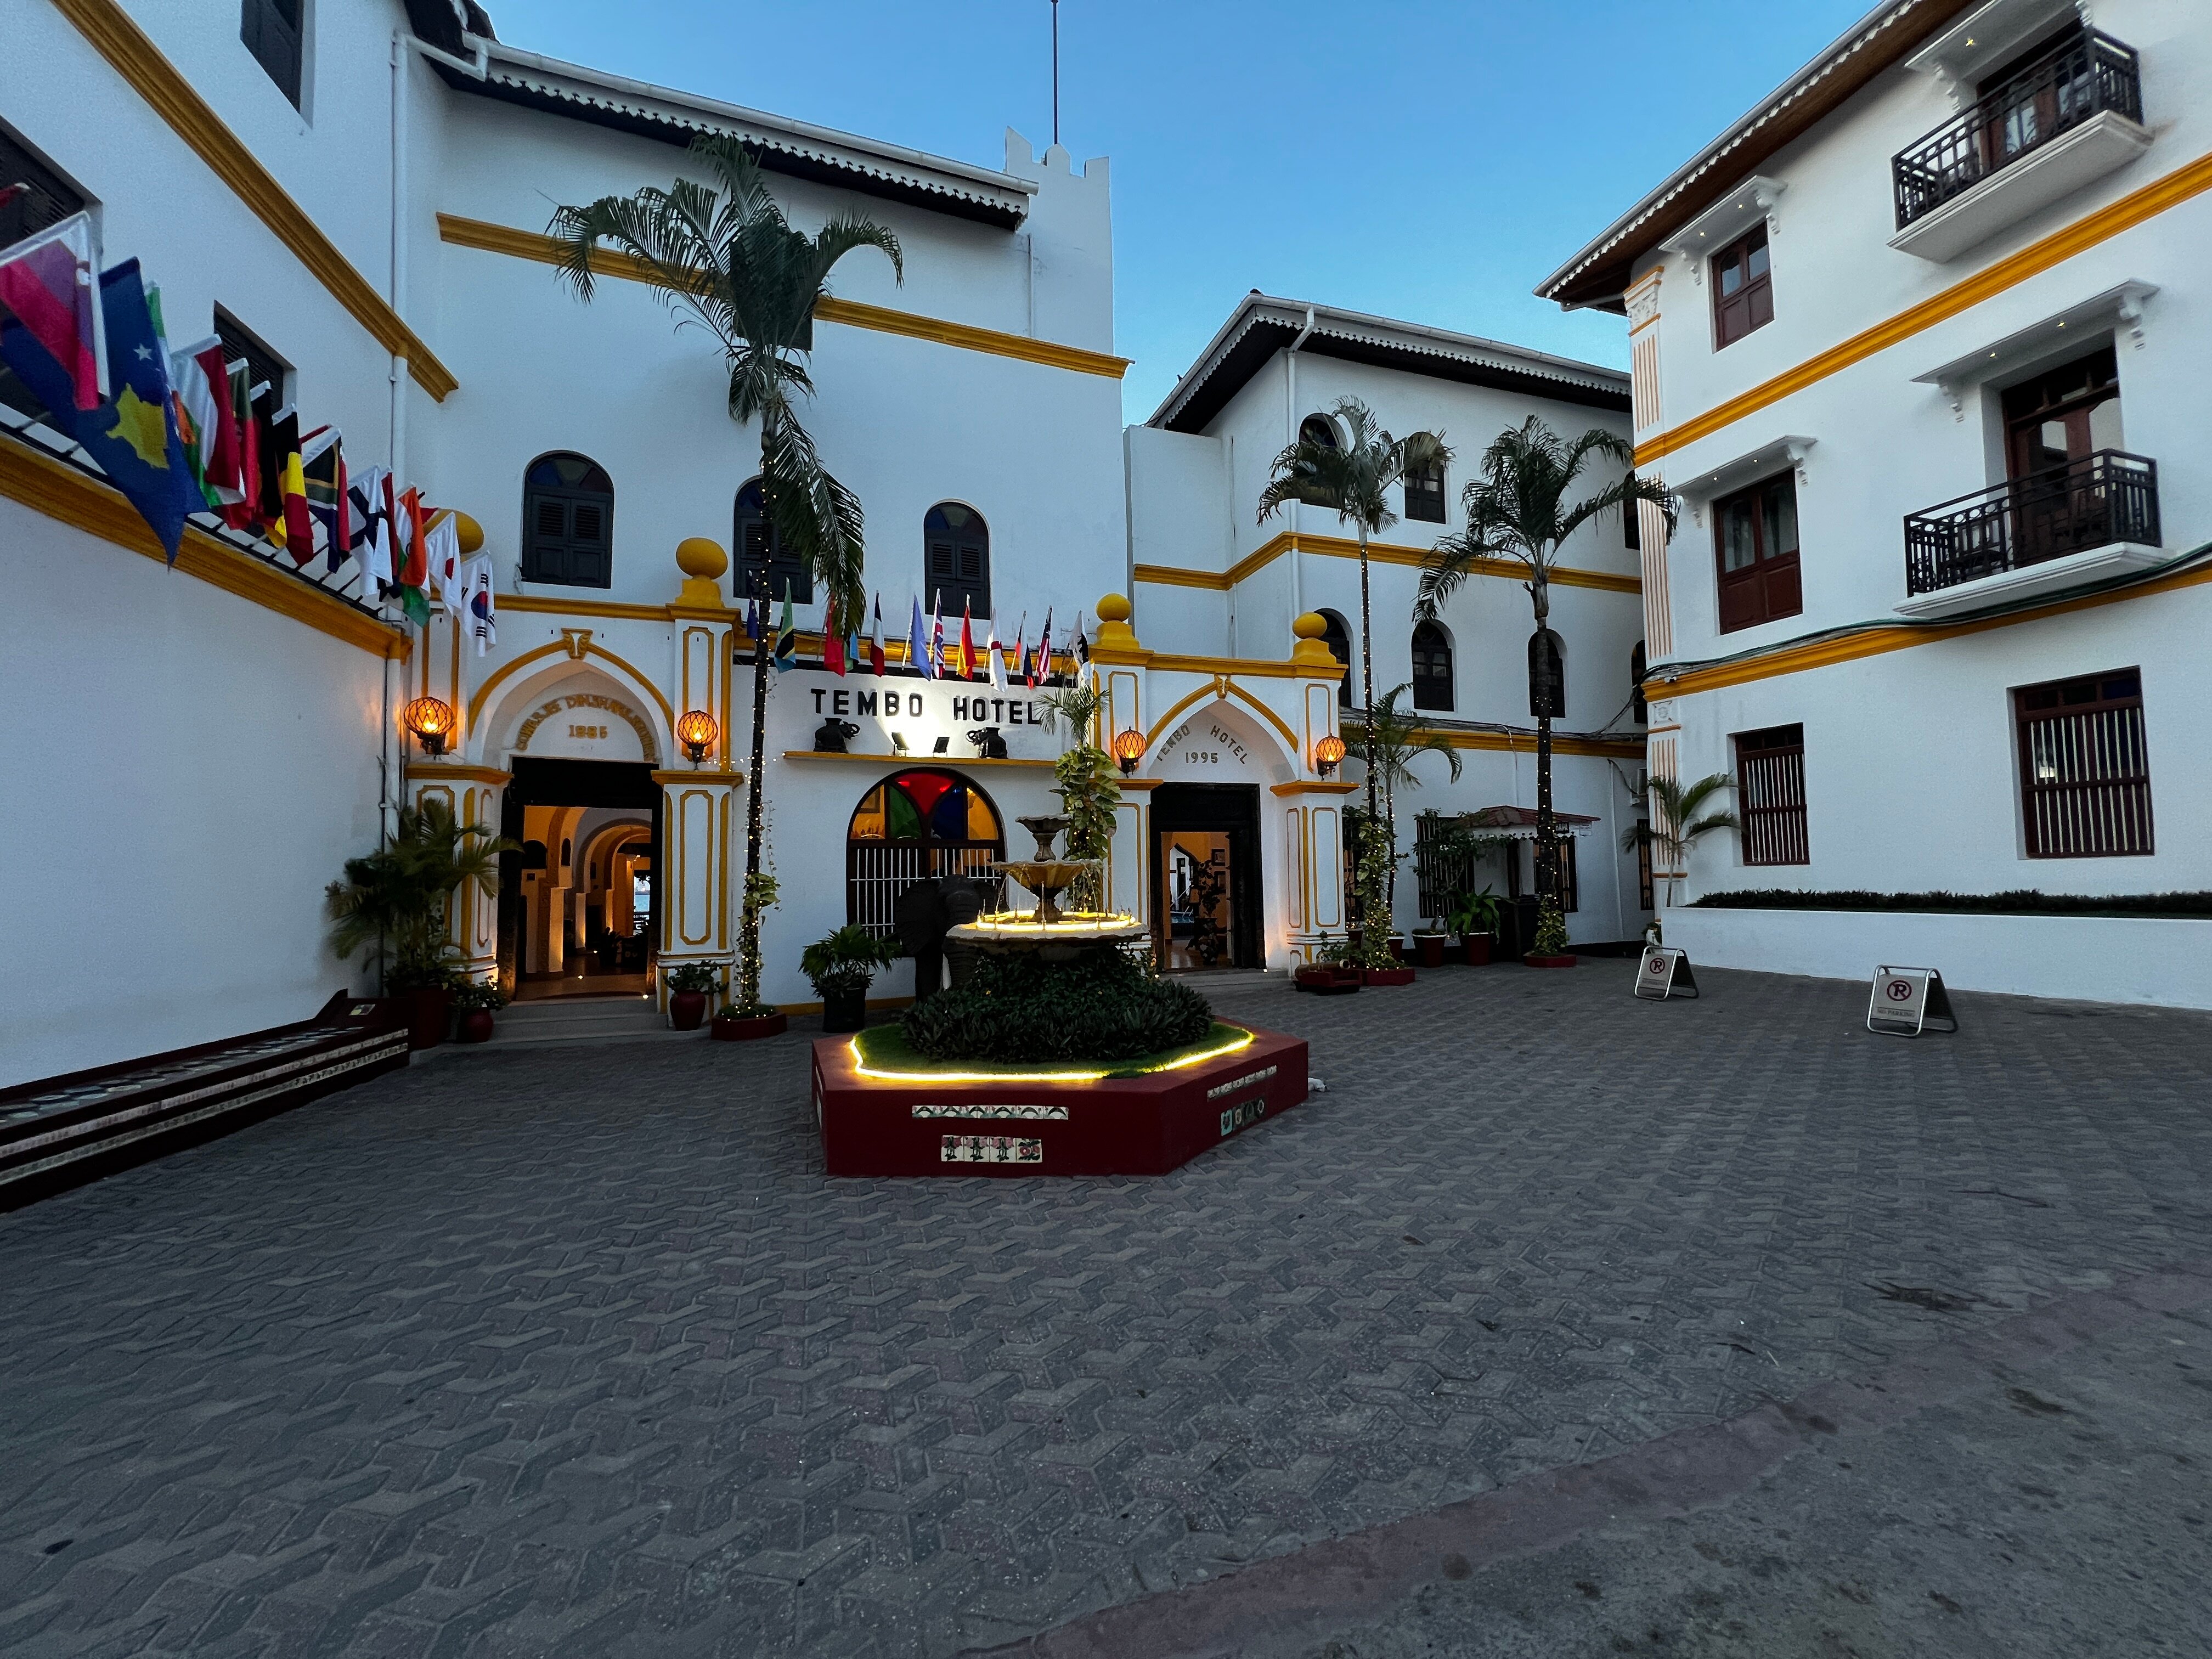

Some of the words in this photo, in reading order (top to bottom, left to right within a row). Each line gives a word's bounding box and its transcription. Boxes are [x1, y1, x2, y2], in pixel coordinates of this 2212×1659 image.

[810, 688, 923, 718] TEMBO
[953, 695, 1042, 725] HOTEL
[569, 725, 608, 739] 1885
[1210, 725, 1248, 764] HOTEL
[1186, 752, 1218, 764] 1995
